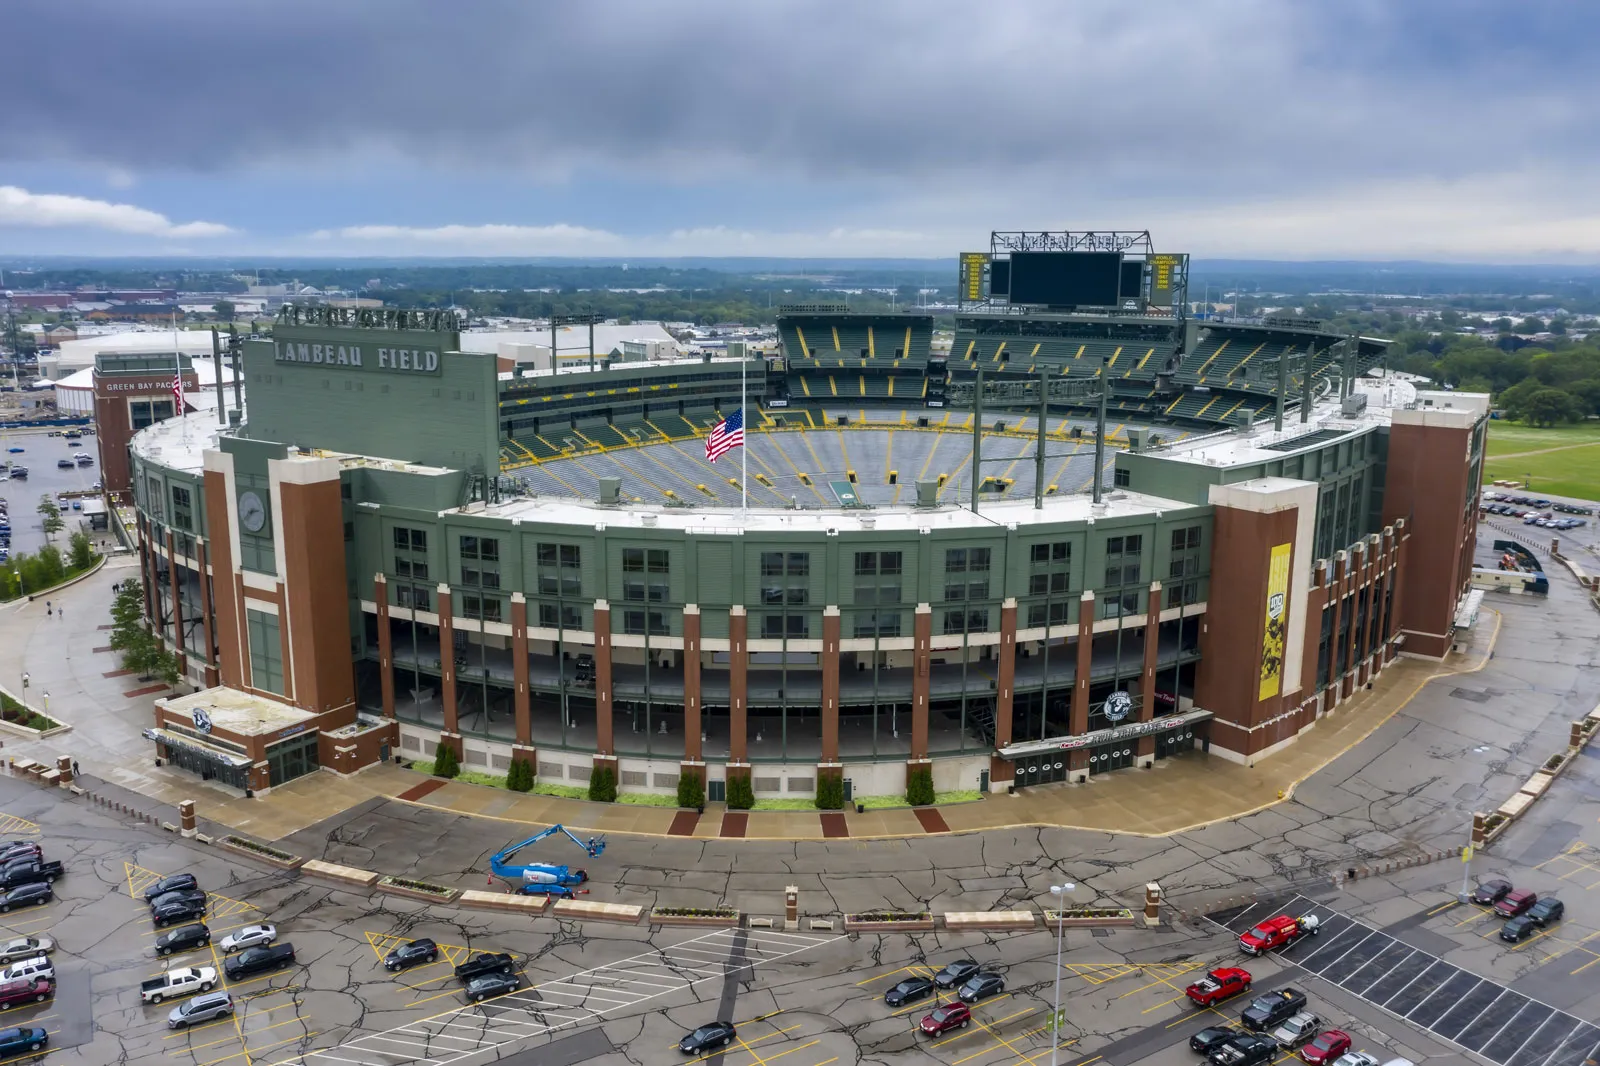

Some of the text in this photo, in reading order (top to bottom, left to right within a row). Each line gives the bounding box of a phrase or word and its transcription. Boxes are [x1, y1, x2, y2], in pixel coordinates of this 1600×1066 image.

[1003, 235, 1133, 249] LAMBEAU FIELD
[274, 340, 438, 373] LAMBEAU FIELD
[106, 381, 193, 391] GREEN BAY PACKRS
